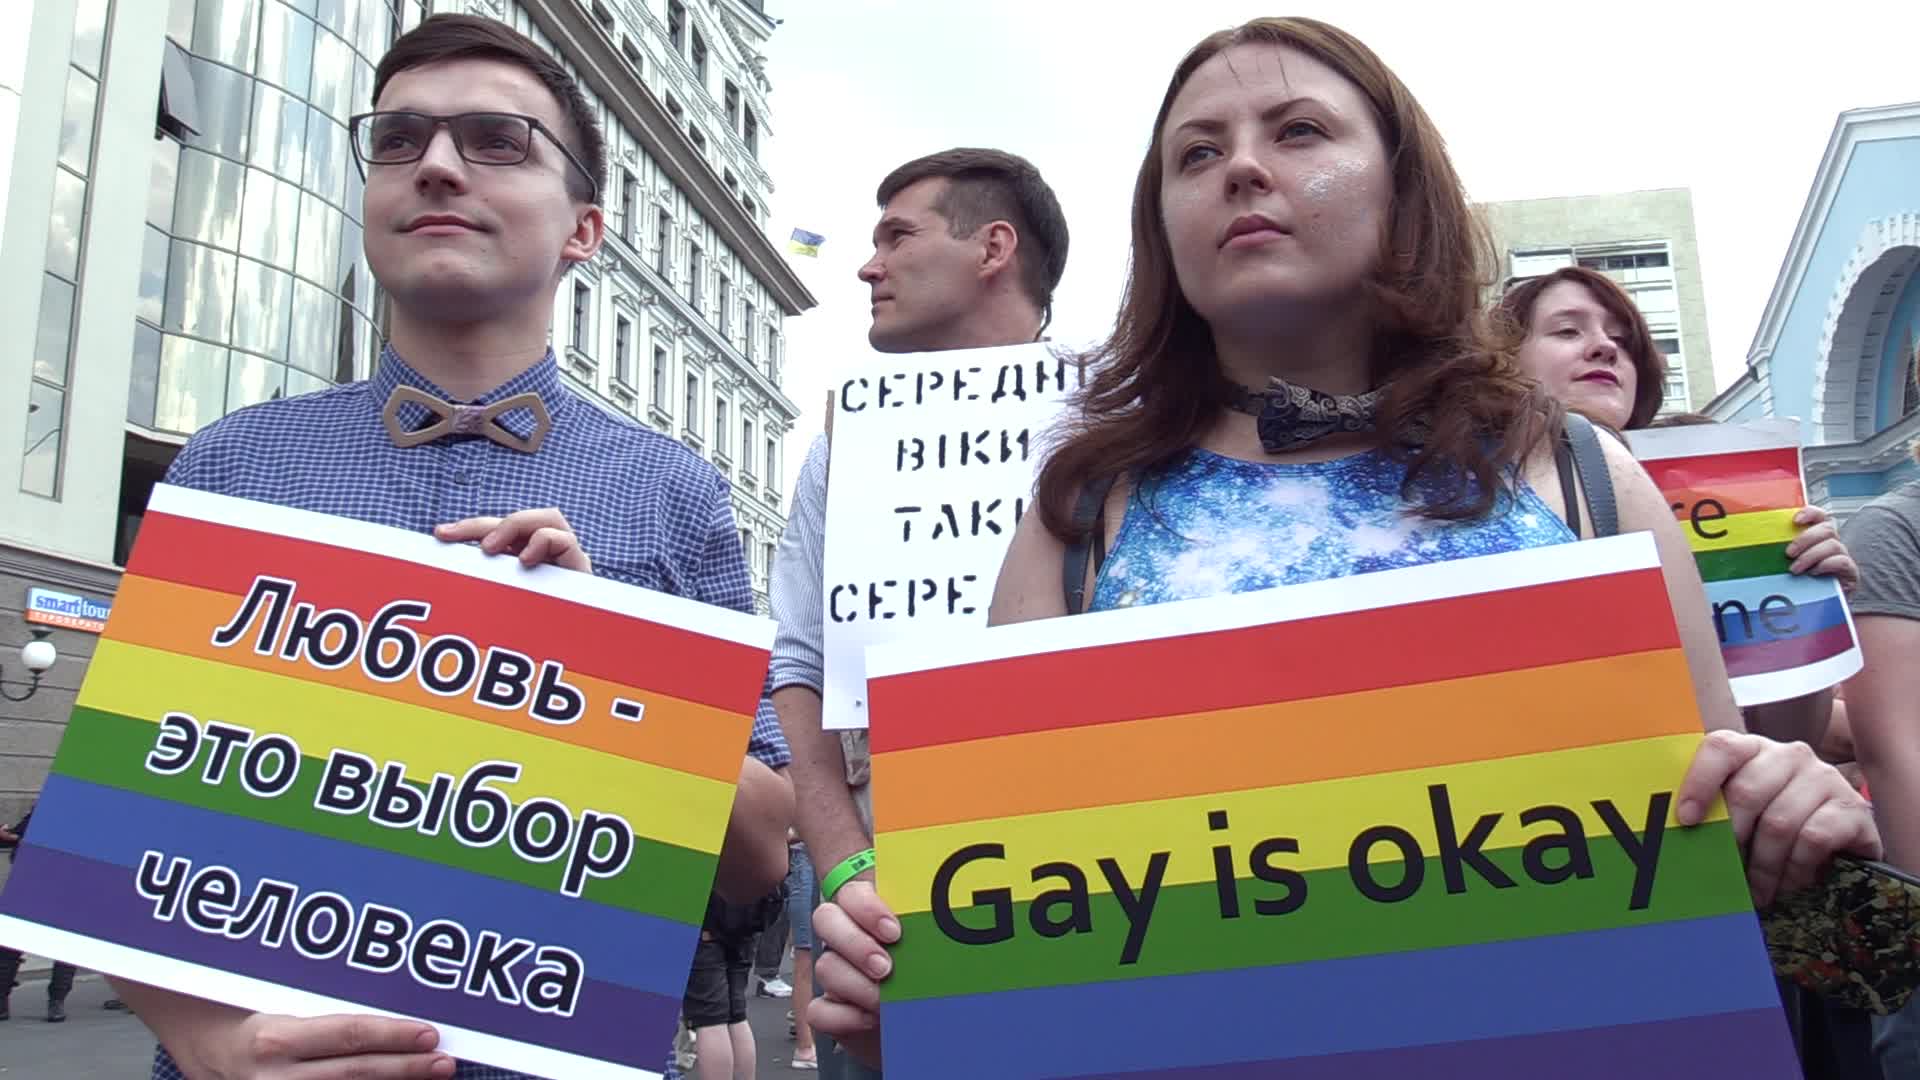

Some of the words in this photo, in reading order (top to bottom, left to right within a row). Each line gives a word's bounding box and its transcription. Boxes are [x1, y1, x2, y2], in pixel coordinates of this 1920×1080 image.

[897, 428, 1029, 472] ВІКИ
[213, 576, 585, 724] Любовь
[146, 712, 300, 797] это
[315, 750, 634, 898] выбор
[930, 843, 1171, 965] Gay
[1207, 810, 1308, 919] is
[1347, 784, 1673, 911] okay
[136, 850, 585, 1016] человека
